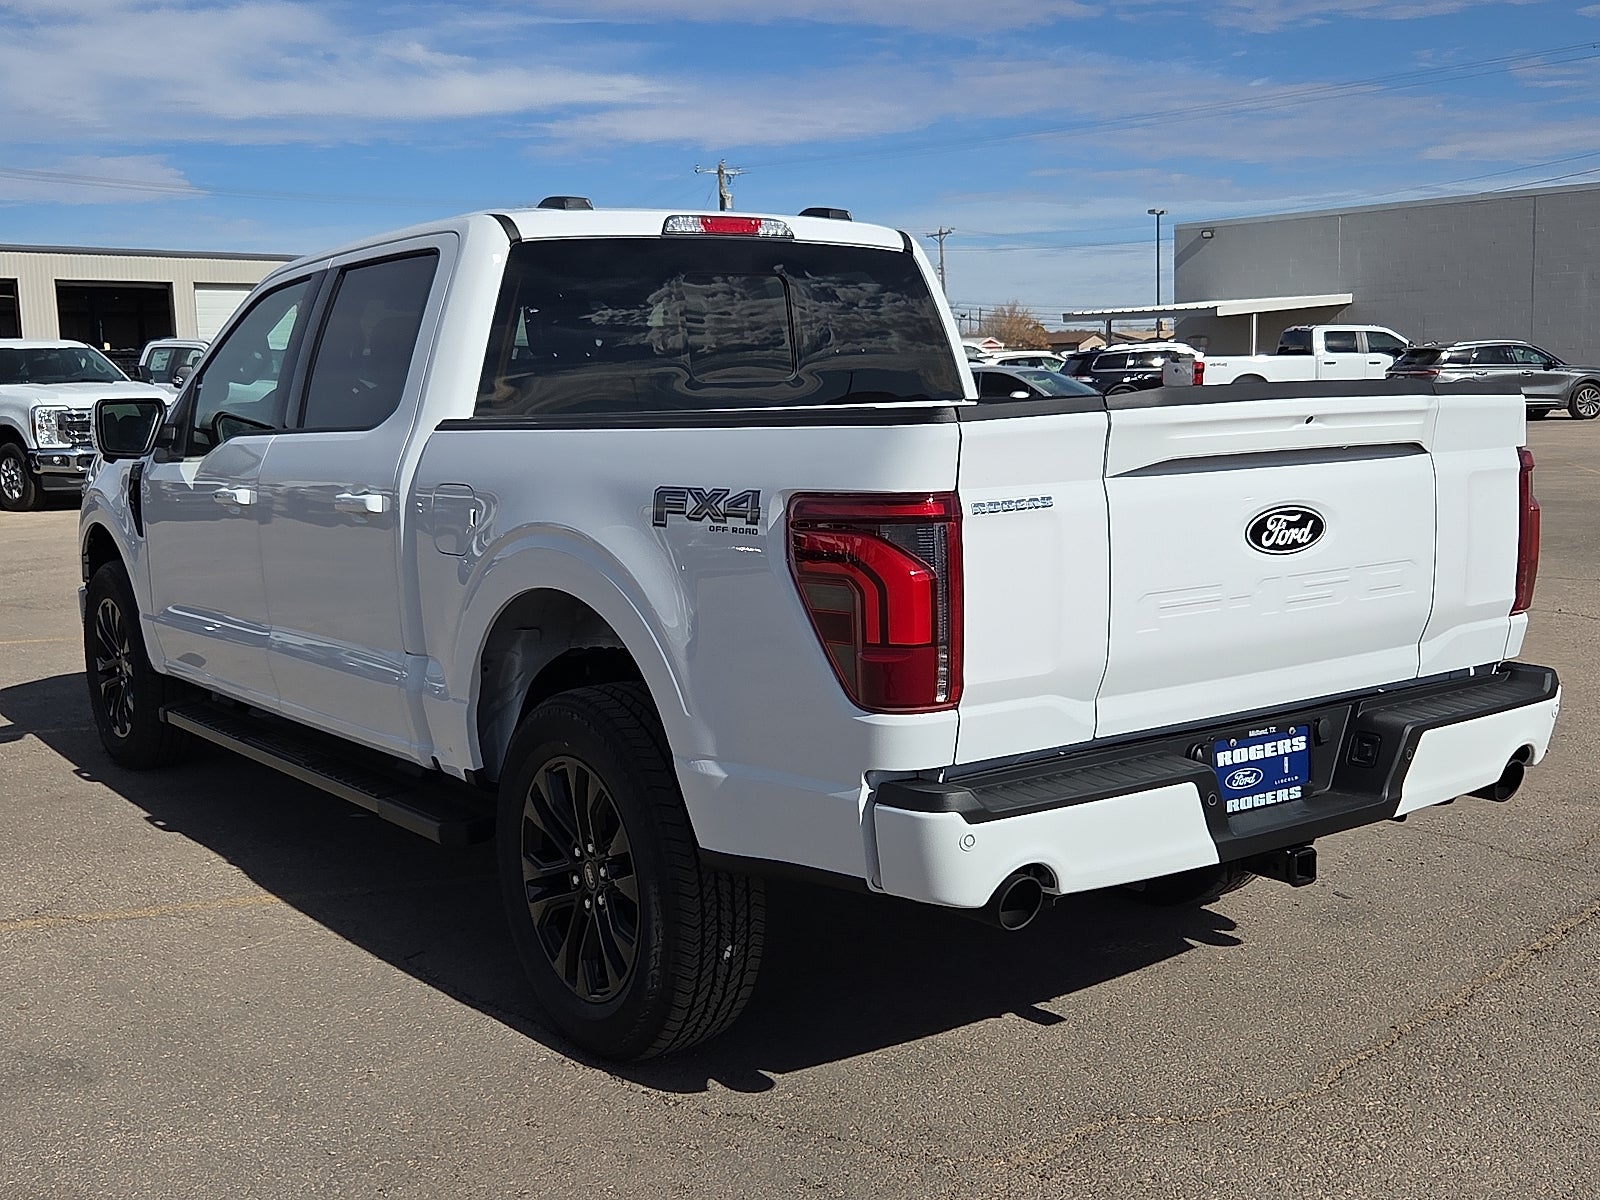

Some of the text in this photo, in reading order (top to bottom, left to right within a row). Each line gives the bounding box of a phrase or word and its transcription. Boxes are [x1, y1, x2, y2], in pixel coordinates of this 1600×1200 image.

[652, 485, 761, 527] FX4
[708, 525, 759, 536] OFF ROAD
[1261, 514, 1314, 547] Ford
[1217, 736, 1307, 767] ROGERS
[1232, 770, 1257, 787] Ford
[1226, 785, 1302, 814] ROGERS
